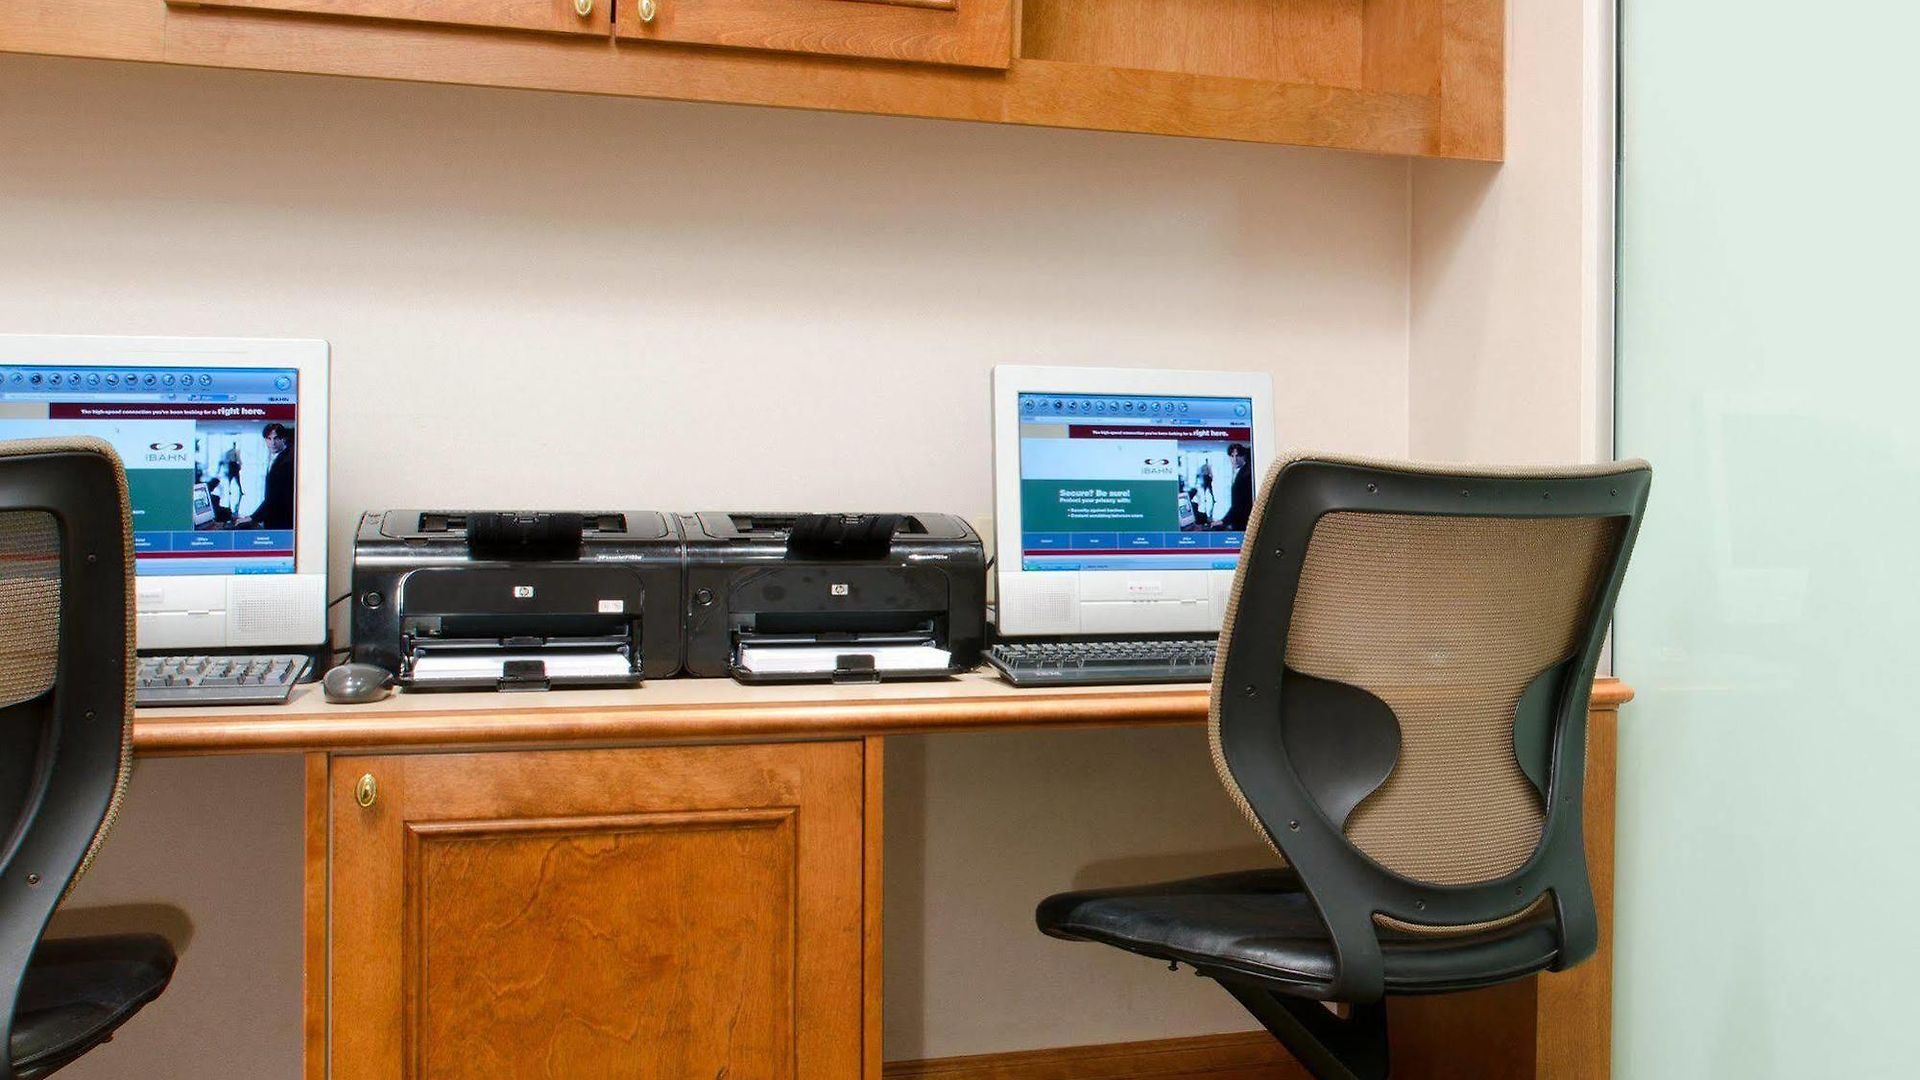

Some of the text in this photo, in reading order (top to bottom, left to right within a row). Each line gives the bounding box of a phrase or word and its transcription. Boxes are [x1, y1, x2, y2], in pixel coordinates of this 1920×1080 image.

[217, 406, 240, 417] right
[241, 407, 266, 416] here.
[1193, 429, 1210, 438] right
